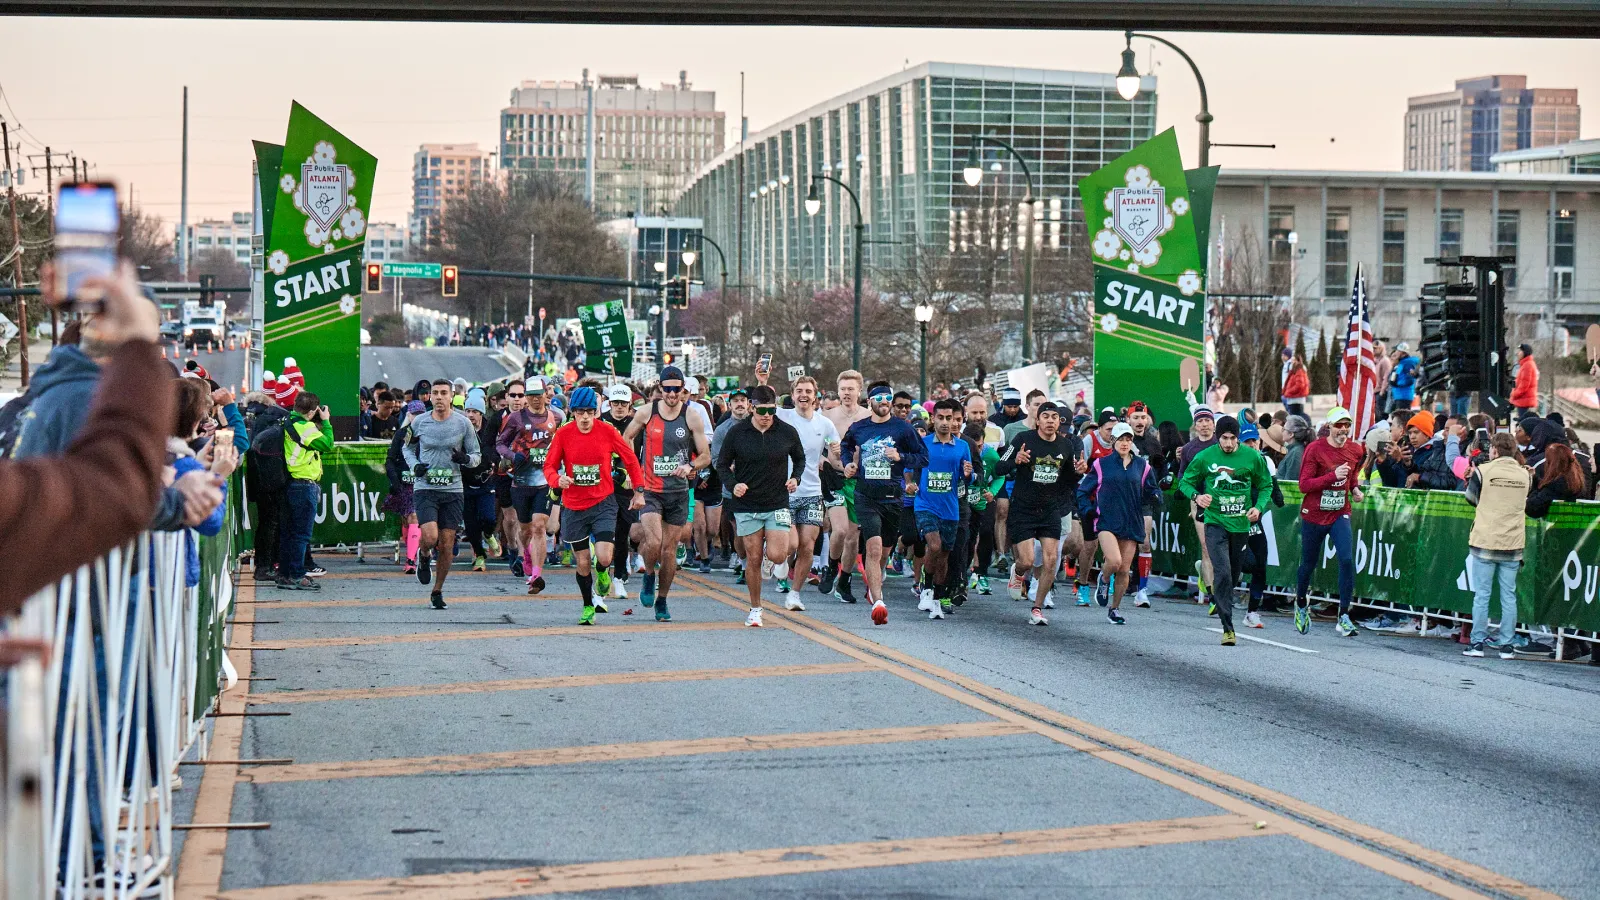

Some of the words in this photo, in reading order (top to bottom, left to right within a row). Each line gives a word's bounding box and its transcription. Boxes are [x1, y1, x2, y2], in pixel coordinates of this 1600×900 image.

[274, 260, 351, 307] START
[392, 265, 422, 276] Magnolia
[1103, 280, 1195, 326] START
[596, 327, 613, 335] WAVE
[602, 335, 612, 347] B
[532, 431, 549, 441] ARC
[314, 481, 381, 524] ublix
[1220, 503, 1245, 512] B1437
[1322, 529, 1395, 578] Pblix
[1562, 550, 1599, 605] Pu
